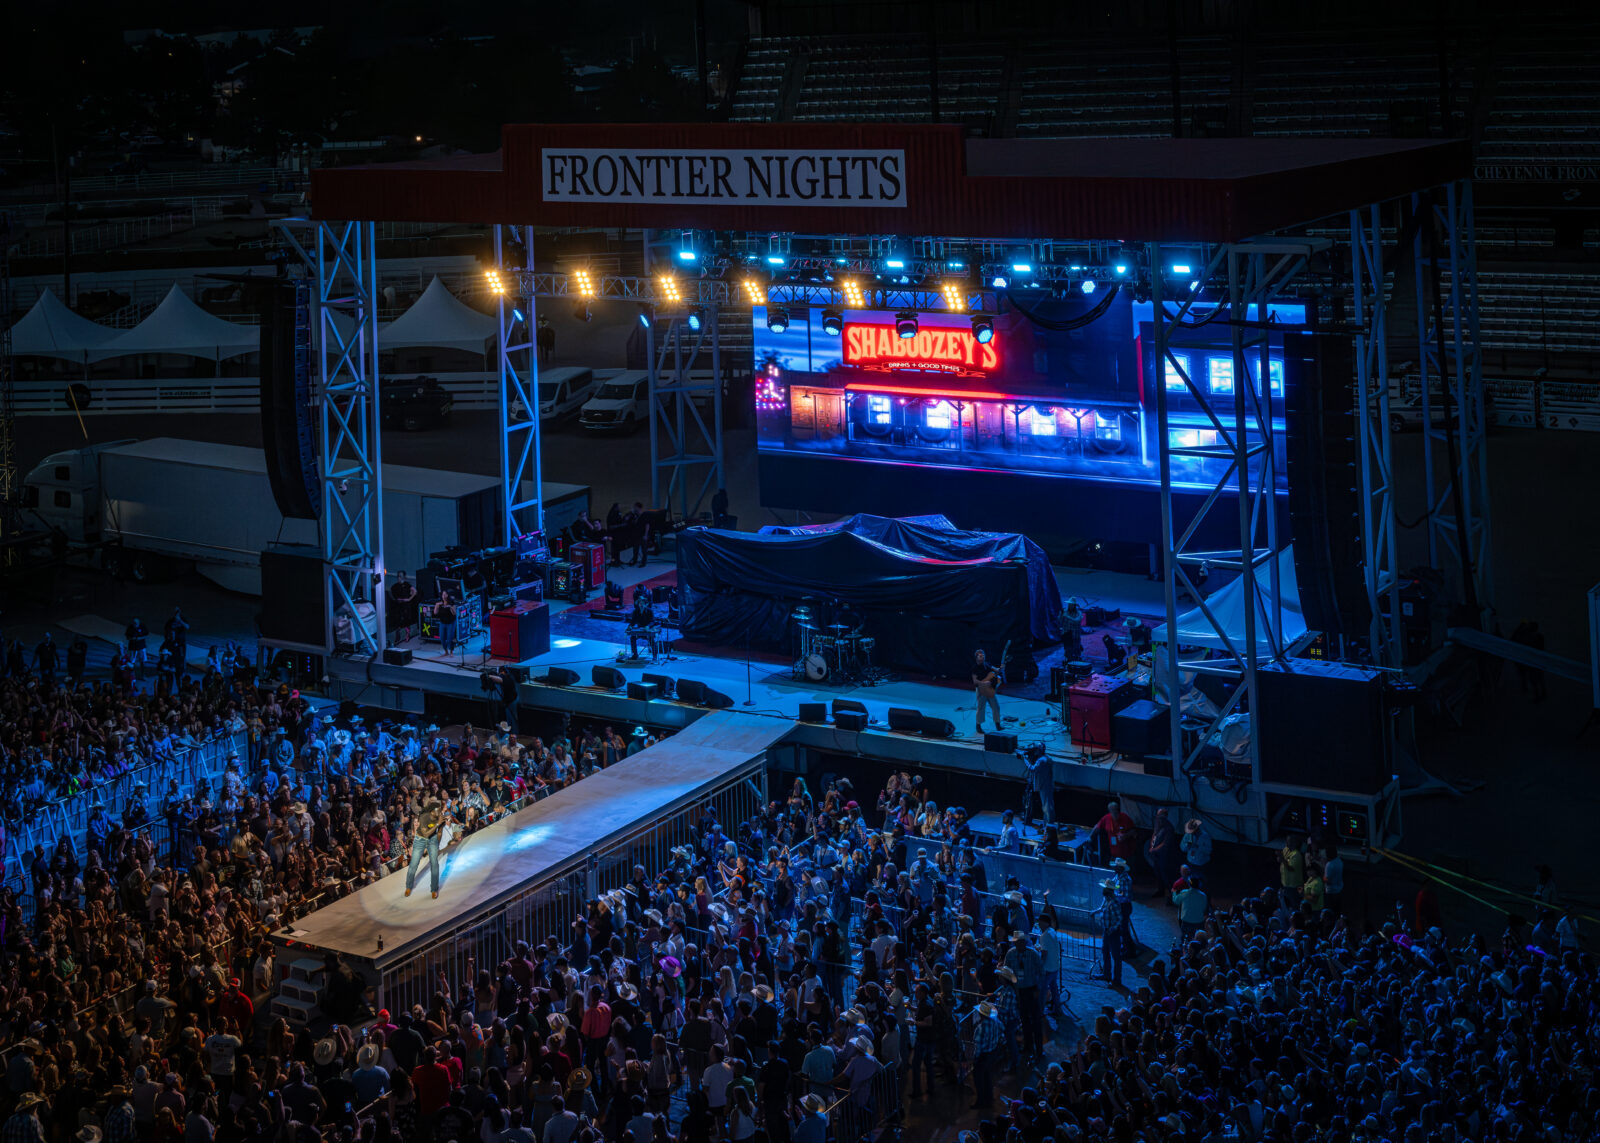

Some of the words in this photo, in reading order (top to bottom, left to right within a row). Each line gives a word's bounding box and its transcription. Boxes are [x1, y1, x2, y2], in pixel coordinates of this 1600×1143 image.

[547, 155, 738, 198] FRONTIER
[745, 155, 900, 200] NIGHTS
[1473, 166, 1553, 179] CHEYENNE
[1557, 166, 1600, 179] FRON
[847, 326, 997, 369] SHABOOZEYS
[941, 364, 960, 372] TIMES
